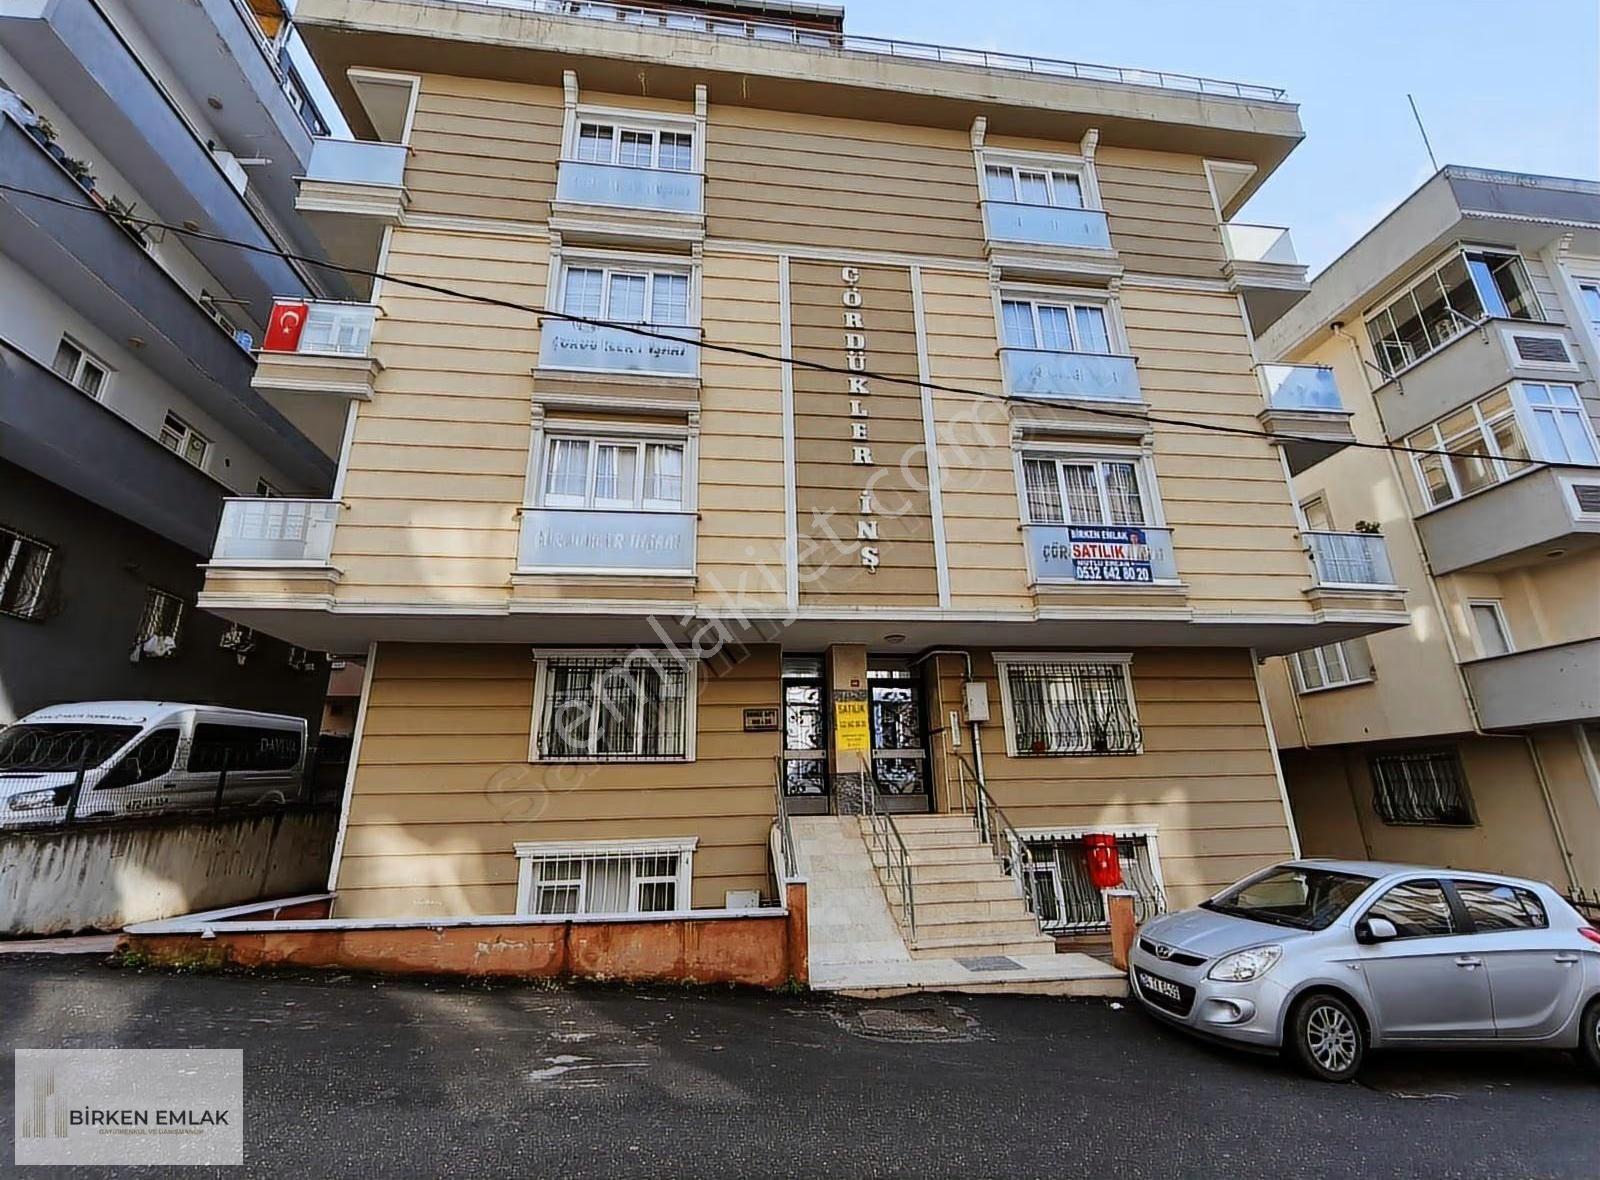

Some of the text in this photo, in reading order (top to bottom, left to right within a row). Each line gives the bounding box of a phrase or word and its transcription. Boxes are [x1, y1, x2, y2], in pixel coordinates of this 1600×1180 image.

[1073, 544, 1125, 559] SATILIK
[1076, 565, 1102, 580] 0532
[1137, 567, 1149, 581] 20
